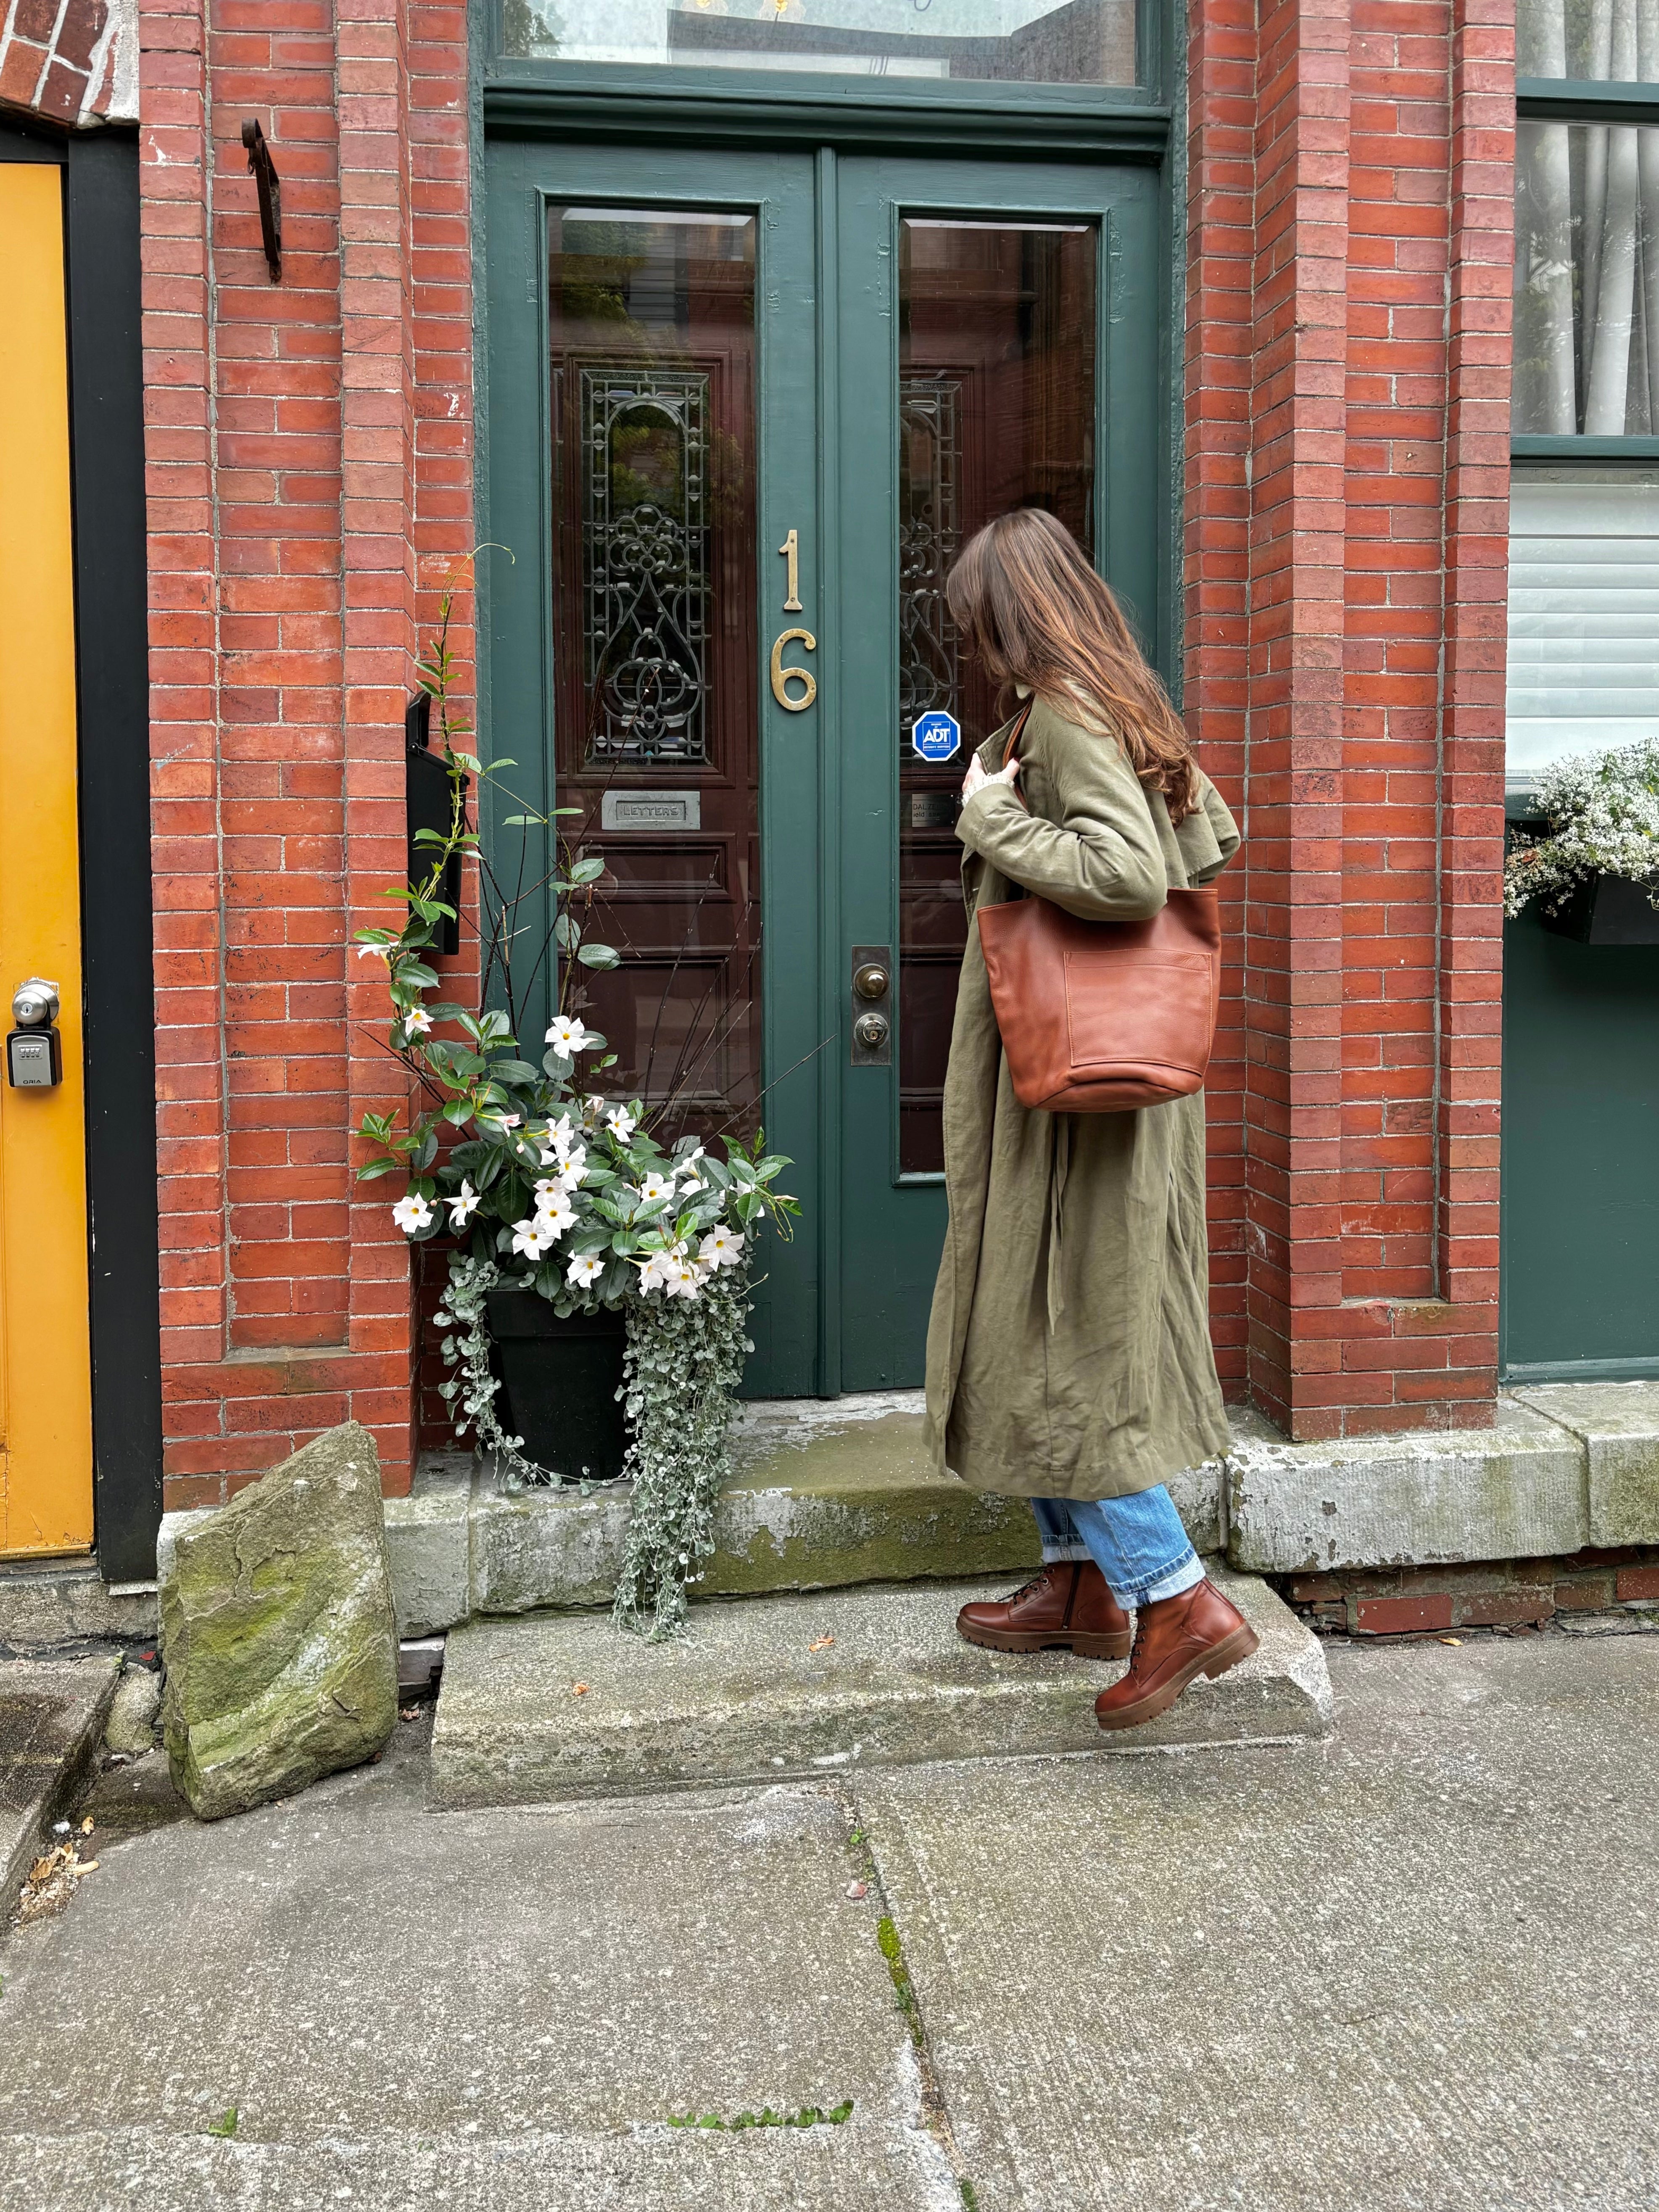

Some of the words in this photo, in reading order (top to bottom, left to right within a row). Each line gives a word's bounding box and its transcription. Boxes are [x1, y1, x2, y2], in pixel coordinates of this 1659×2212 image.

[770, 529, 816, 711] 16
[923, 728, 950, 743] ADT
[623, 806, 679, 816] LETTERS
